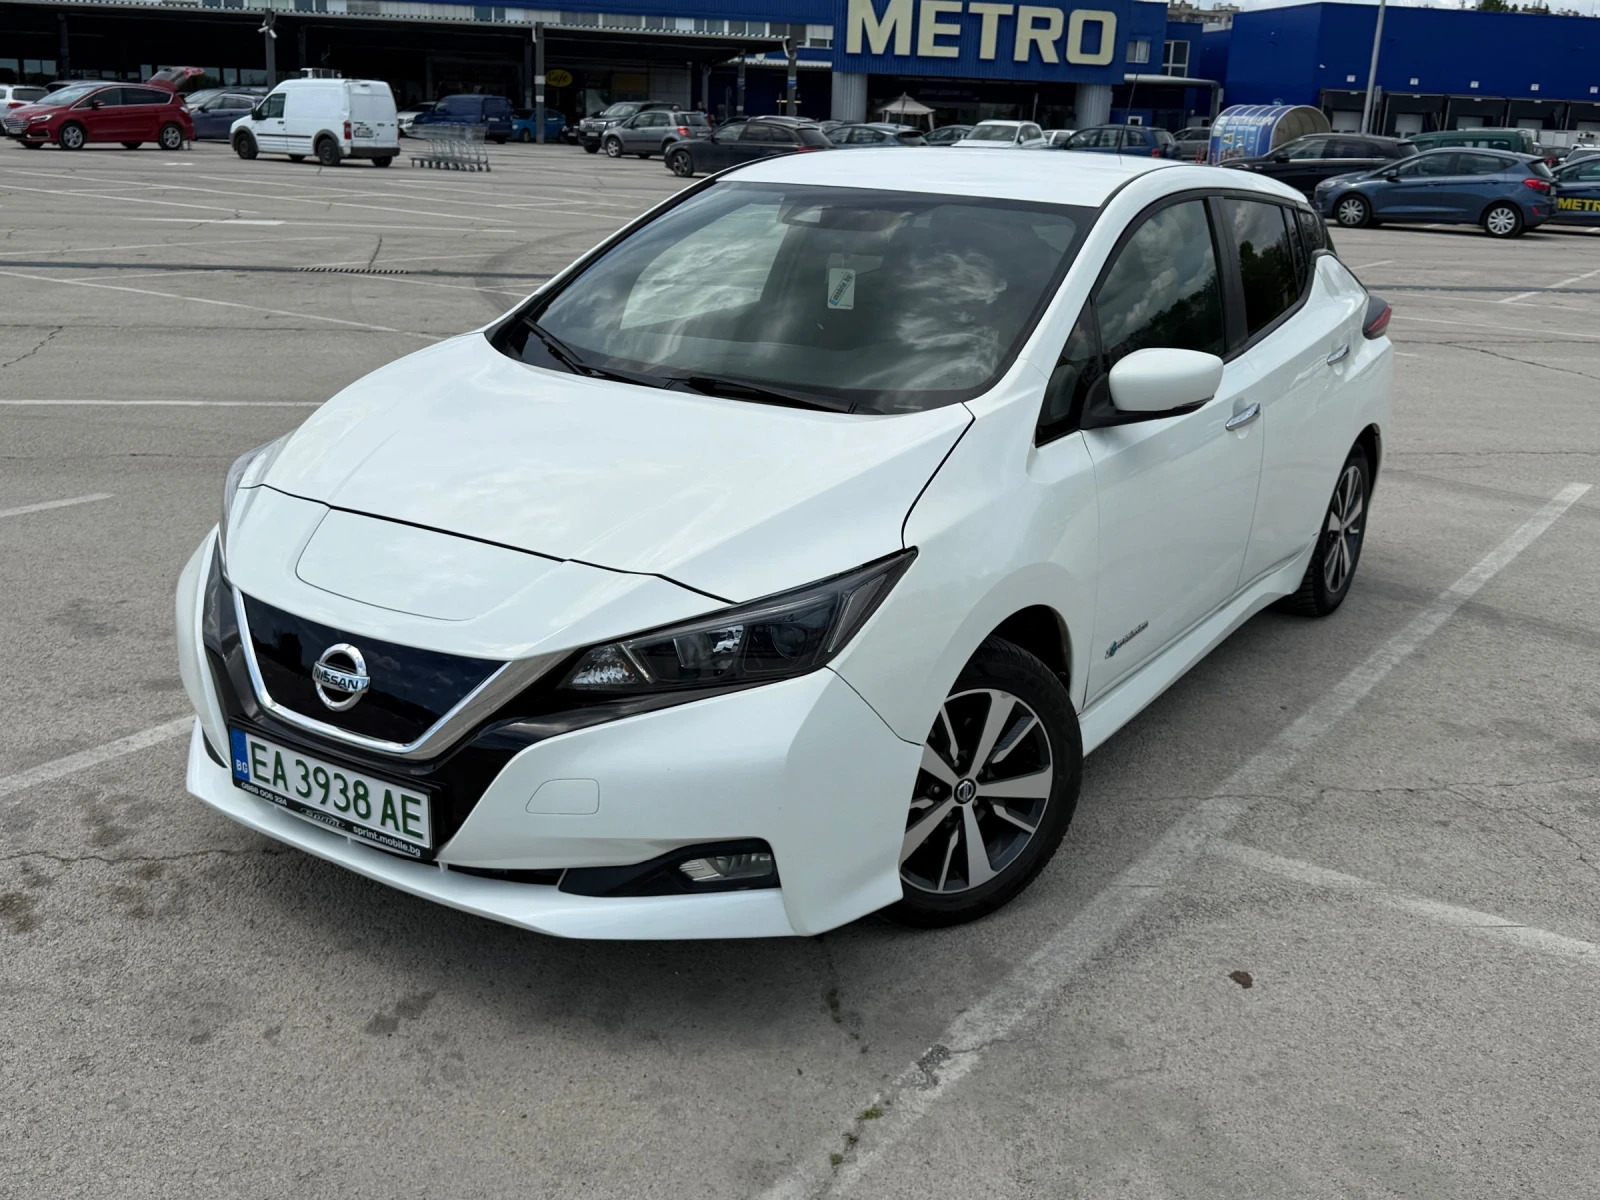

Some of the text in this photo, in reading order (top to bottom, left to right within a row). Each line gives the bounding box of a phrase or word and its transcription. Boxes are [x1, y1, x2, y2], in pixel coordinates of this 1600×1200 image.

[846, 0, 1117, 66] METRO
[314, 667, 358, 690] NISSAN
[236, 759, 248, 774] BG
[251, 741, 424, 840] EA 3938 AE
[353, 826, 421, 857] sprint.mobile.bg
